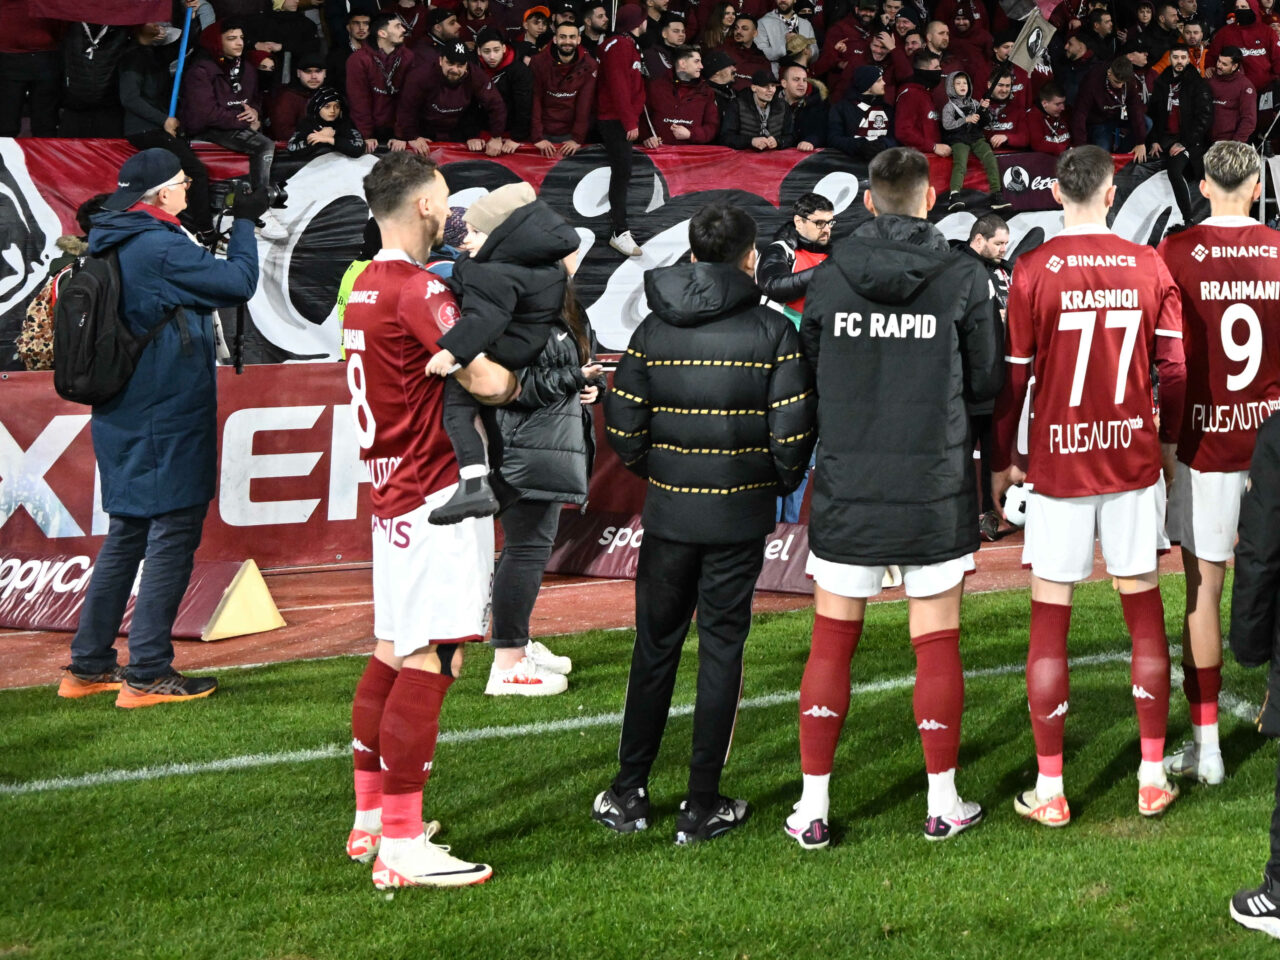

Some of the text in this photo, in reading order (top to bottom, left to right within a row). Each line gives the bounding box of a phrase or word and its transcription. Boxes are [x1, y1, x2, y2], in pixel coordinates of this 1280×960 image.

[1067, 254, 1137, 268] BINANCE
[1211, 245, 1278, 258] BINANCE
[1060, 289, 1139, 310] KRASNIQI
[1200, 281, 1280, 301] RRAHMANI
[833, 312, 937, 339] FC RAPID
[1058, 310, 1143, 407] 77
[1220, 303, 1263, 391] 9
[347, 353, 376, 449] 8
